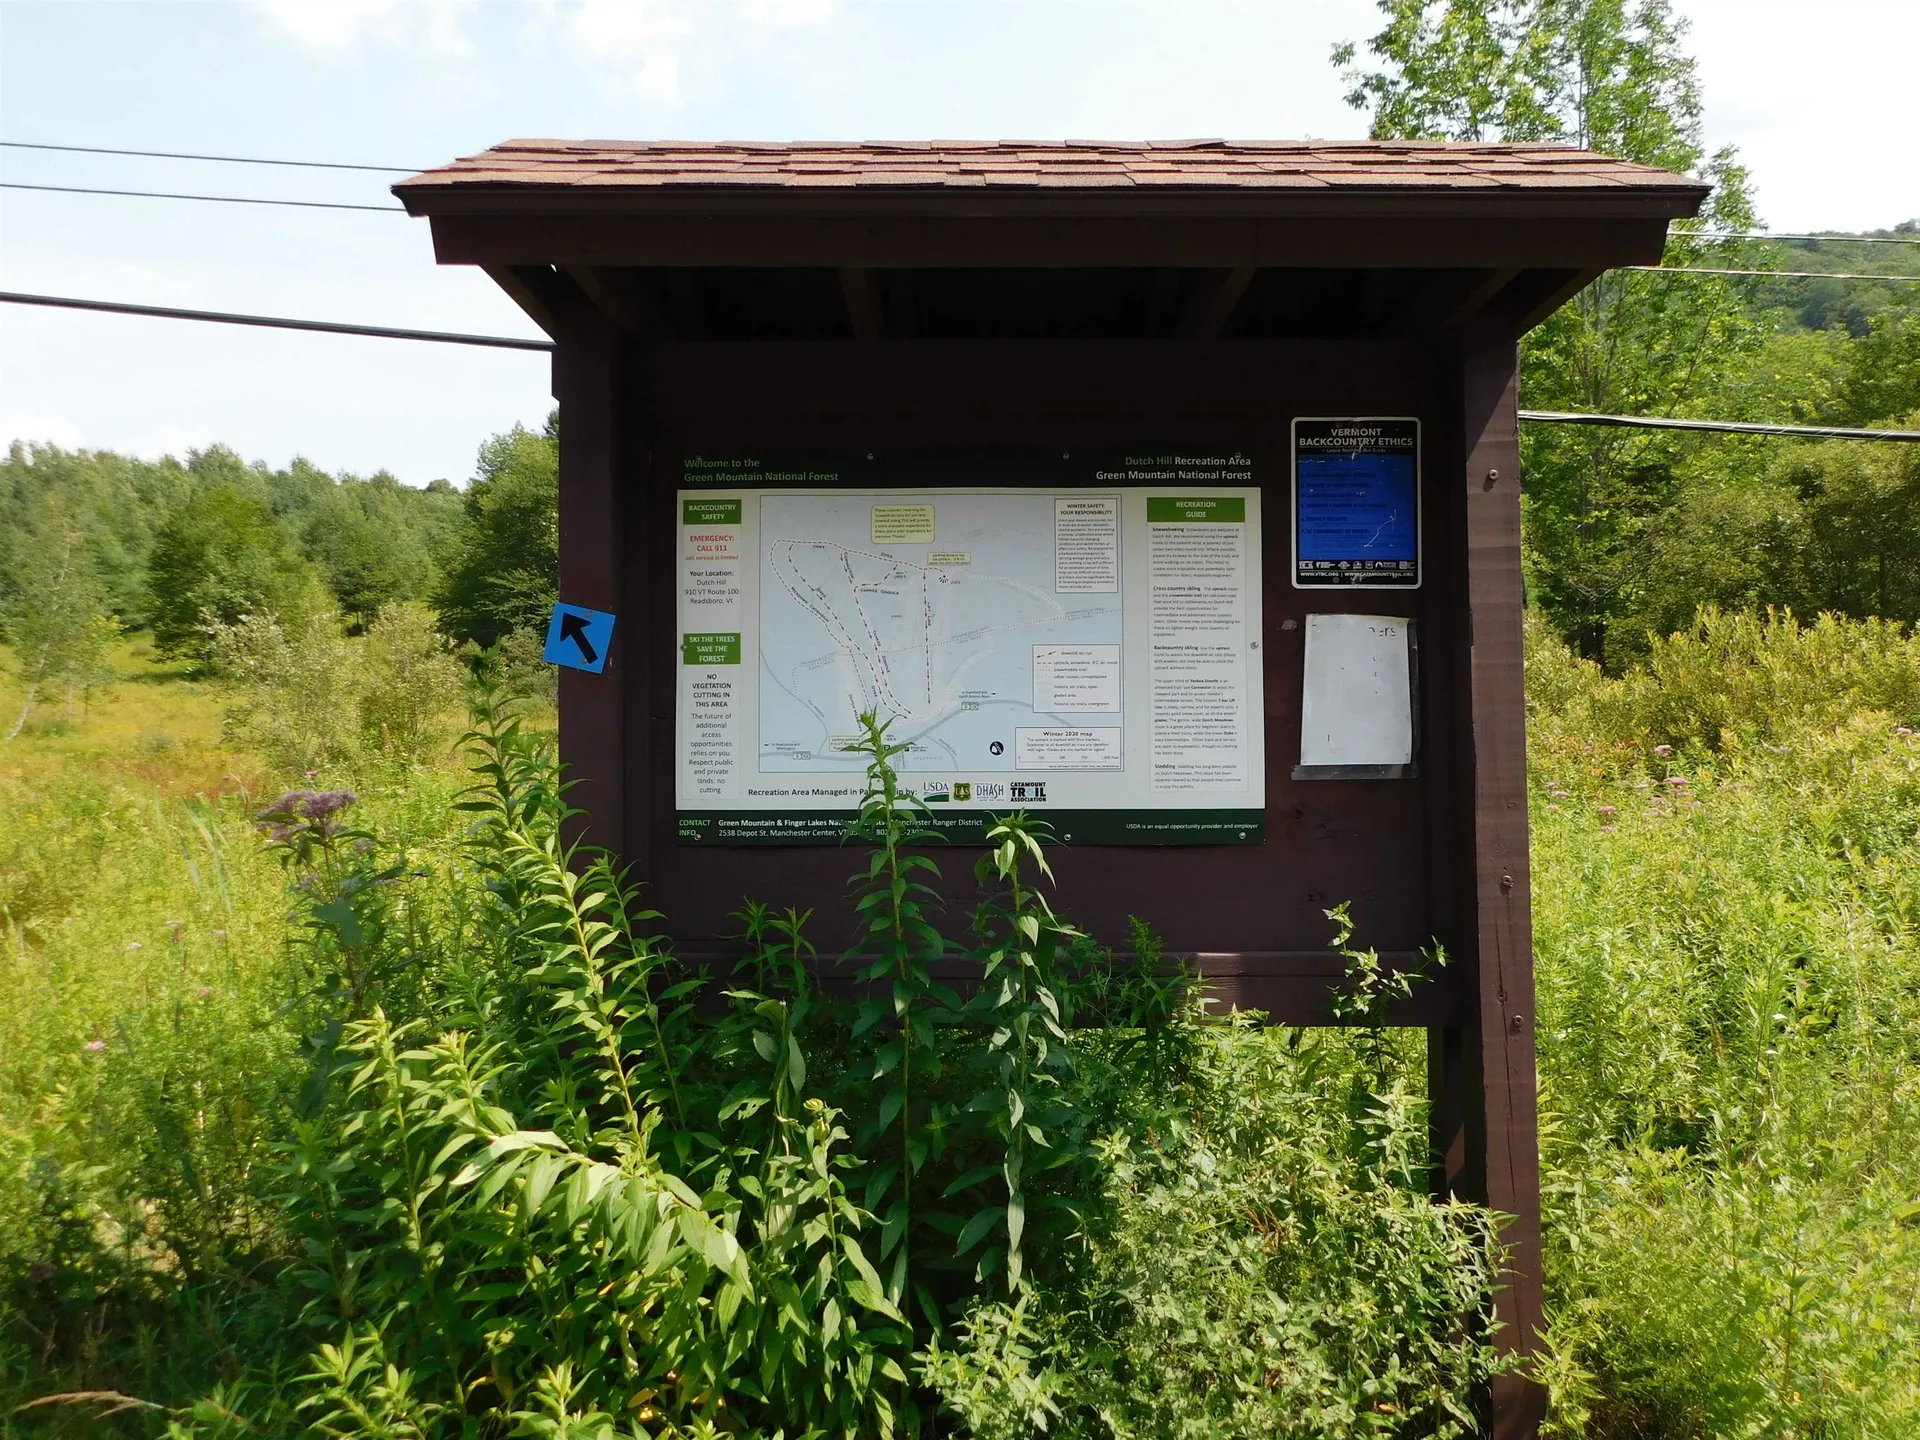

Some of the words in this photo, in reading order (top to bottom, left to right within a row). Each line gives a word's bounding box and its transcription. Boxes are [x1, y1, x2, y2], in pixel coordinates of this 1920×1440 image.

[1331, 429, 1383, 437] VERMONT
[1300, 438, 1376, 446] BACKCOUNTRY
[1378, 438, 1413, 446] ETHICS
[684, 459, 729, 468] Welcome
[731, 459, 741, 468] to
[744, 459, 760, 468] the
[1126, 457, 1154, 465] Dutch
[1156, 457, 1172, 465] Hill
[1175, 457, 1226, 465] Recreation
[1228, 457, 1251, 465] Area
[684, 472, 713, 482] Green
[716, 472, 762, 482] Mountain
[765, 472, 806, 482] National
[809, 472, 839, 482] Forest
[1096, 471, 1126, 480] Green
[1128, 471, 1176, 480] Mountain
[1178, 471, 1219, 480] National
[1222, 471, 1251, 480] Forest
[924, 782, 949, 792] USDA
[976, 784, 1004, 799] DHASH
[812, 788, 848, 797] Managed
[850, 788, 858, 796] in
[784, 819, 806, 828] Finger
[933, 819, 956, 828] Ranger
[737, 830, 758, 838] Depot
[812, 829, 837, 837] Center,
